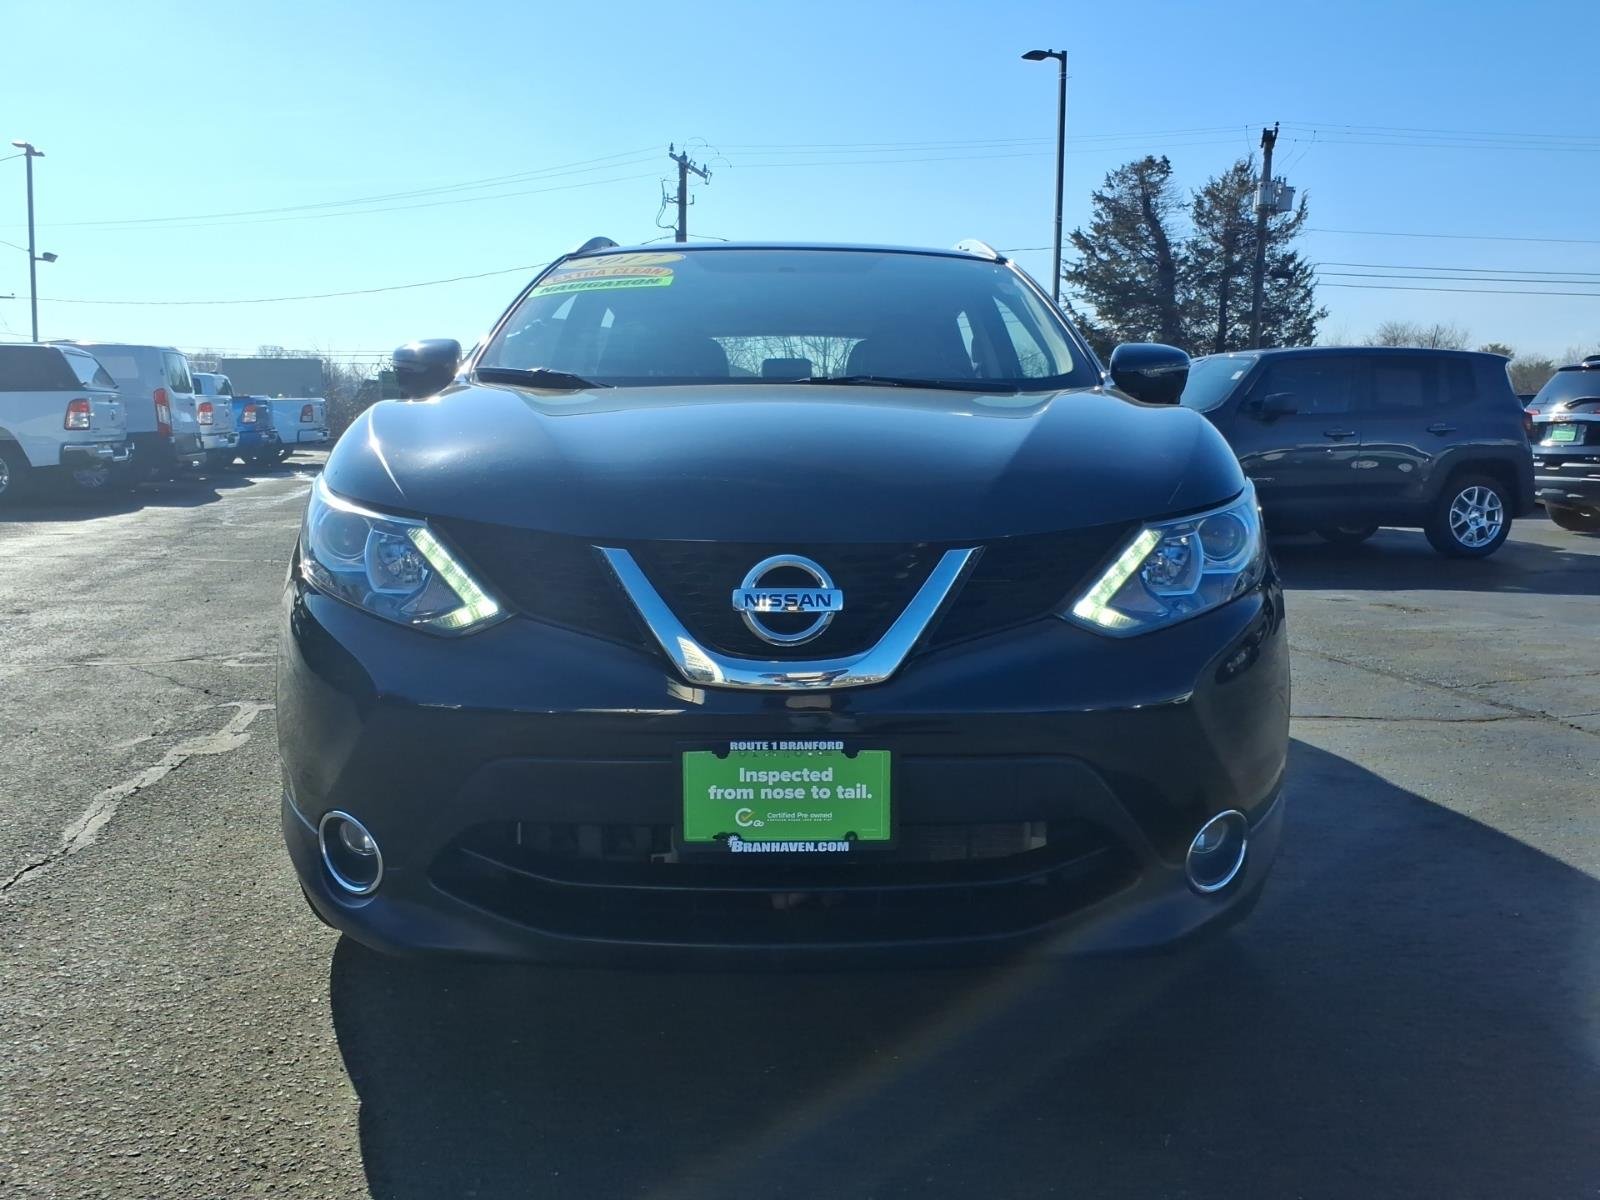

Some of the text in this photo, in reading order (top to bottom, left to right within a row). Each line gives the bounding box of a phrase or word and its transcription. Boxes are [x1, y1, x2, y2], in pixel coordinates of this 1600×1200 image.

[612, 266, 664, 275] CLEAN
[540, 278, 661, 294] NAVIGATION
[744, 593, 832, 608] NISSAN
[730, 741, 844, 750] ROUTE 1 BRANFORD
[739, 767, 833, 785] Inspected
[708, 783, 872, 799] from nose to tail.
[767, 811, 796, 819] Certified
[731, 840, 849, 852] BRANHAVEN.COM
